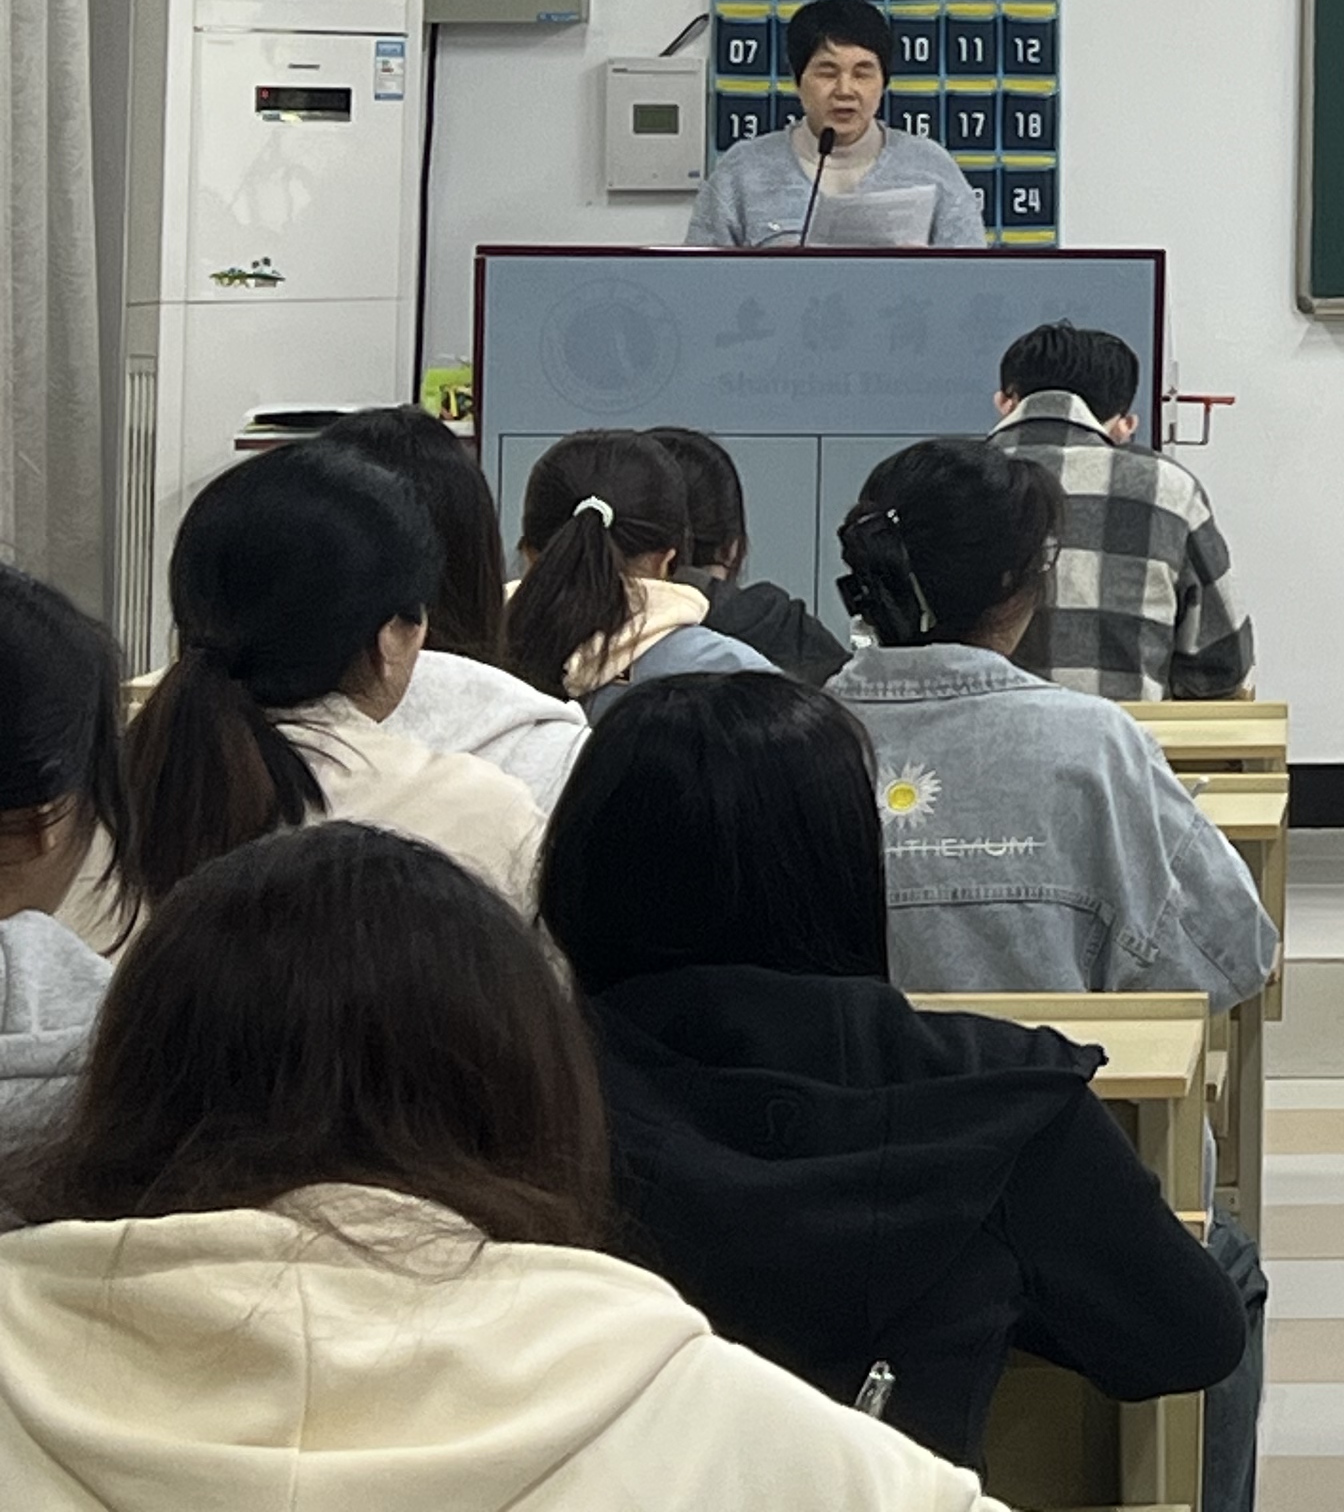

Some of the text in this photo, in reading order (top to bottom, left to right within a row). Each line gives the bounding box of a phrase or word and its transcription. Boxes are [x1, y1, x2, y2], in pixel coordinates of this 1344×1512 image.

[729, 39, 758, 63] 07
[901, 36, 929, 62] 10
[958, 37, 983, 62] 11
[1014, 37, 1040, 63] 12
[730, 113, 758, 139] 13
[902, 112, 930, 138] 16
[958, 112, 985, 137] 17
[1015, 112, 1041, 138] 18
[1013, 188, 1041, 213] 24
